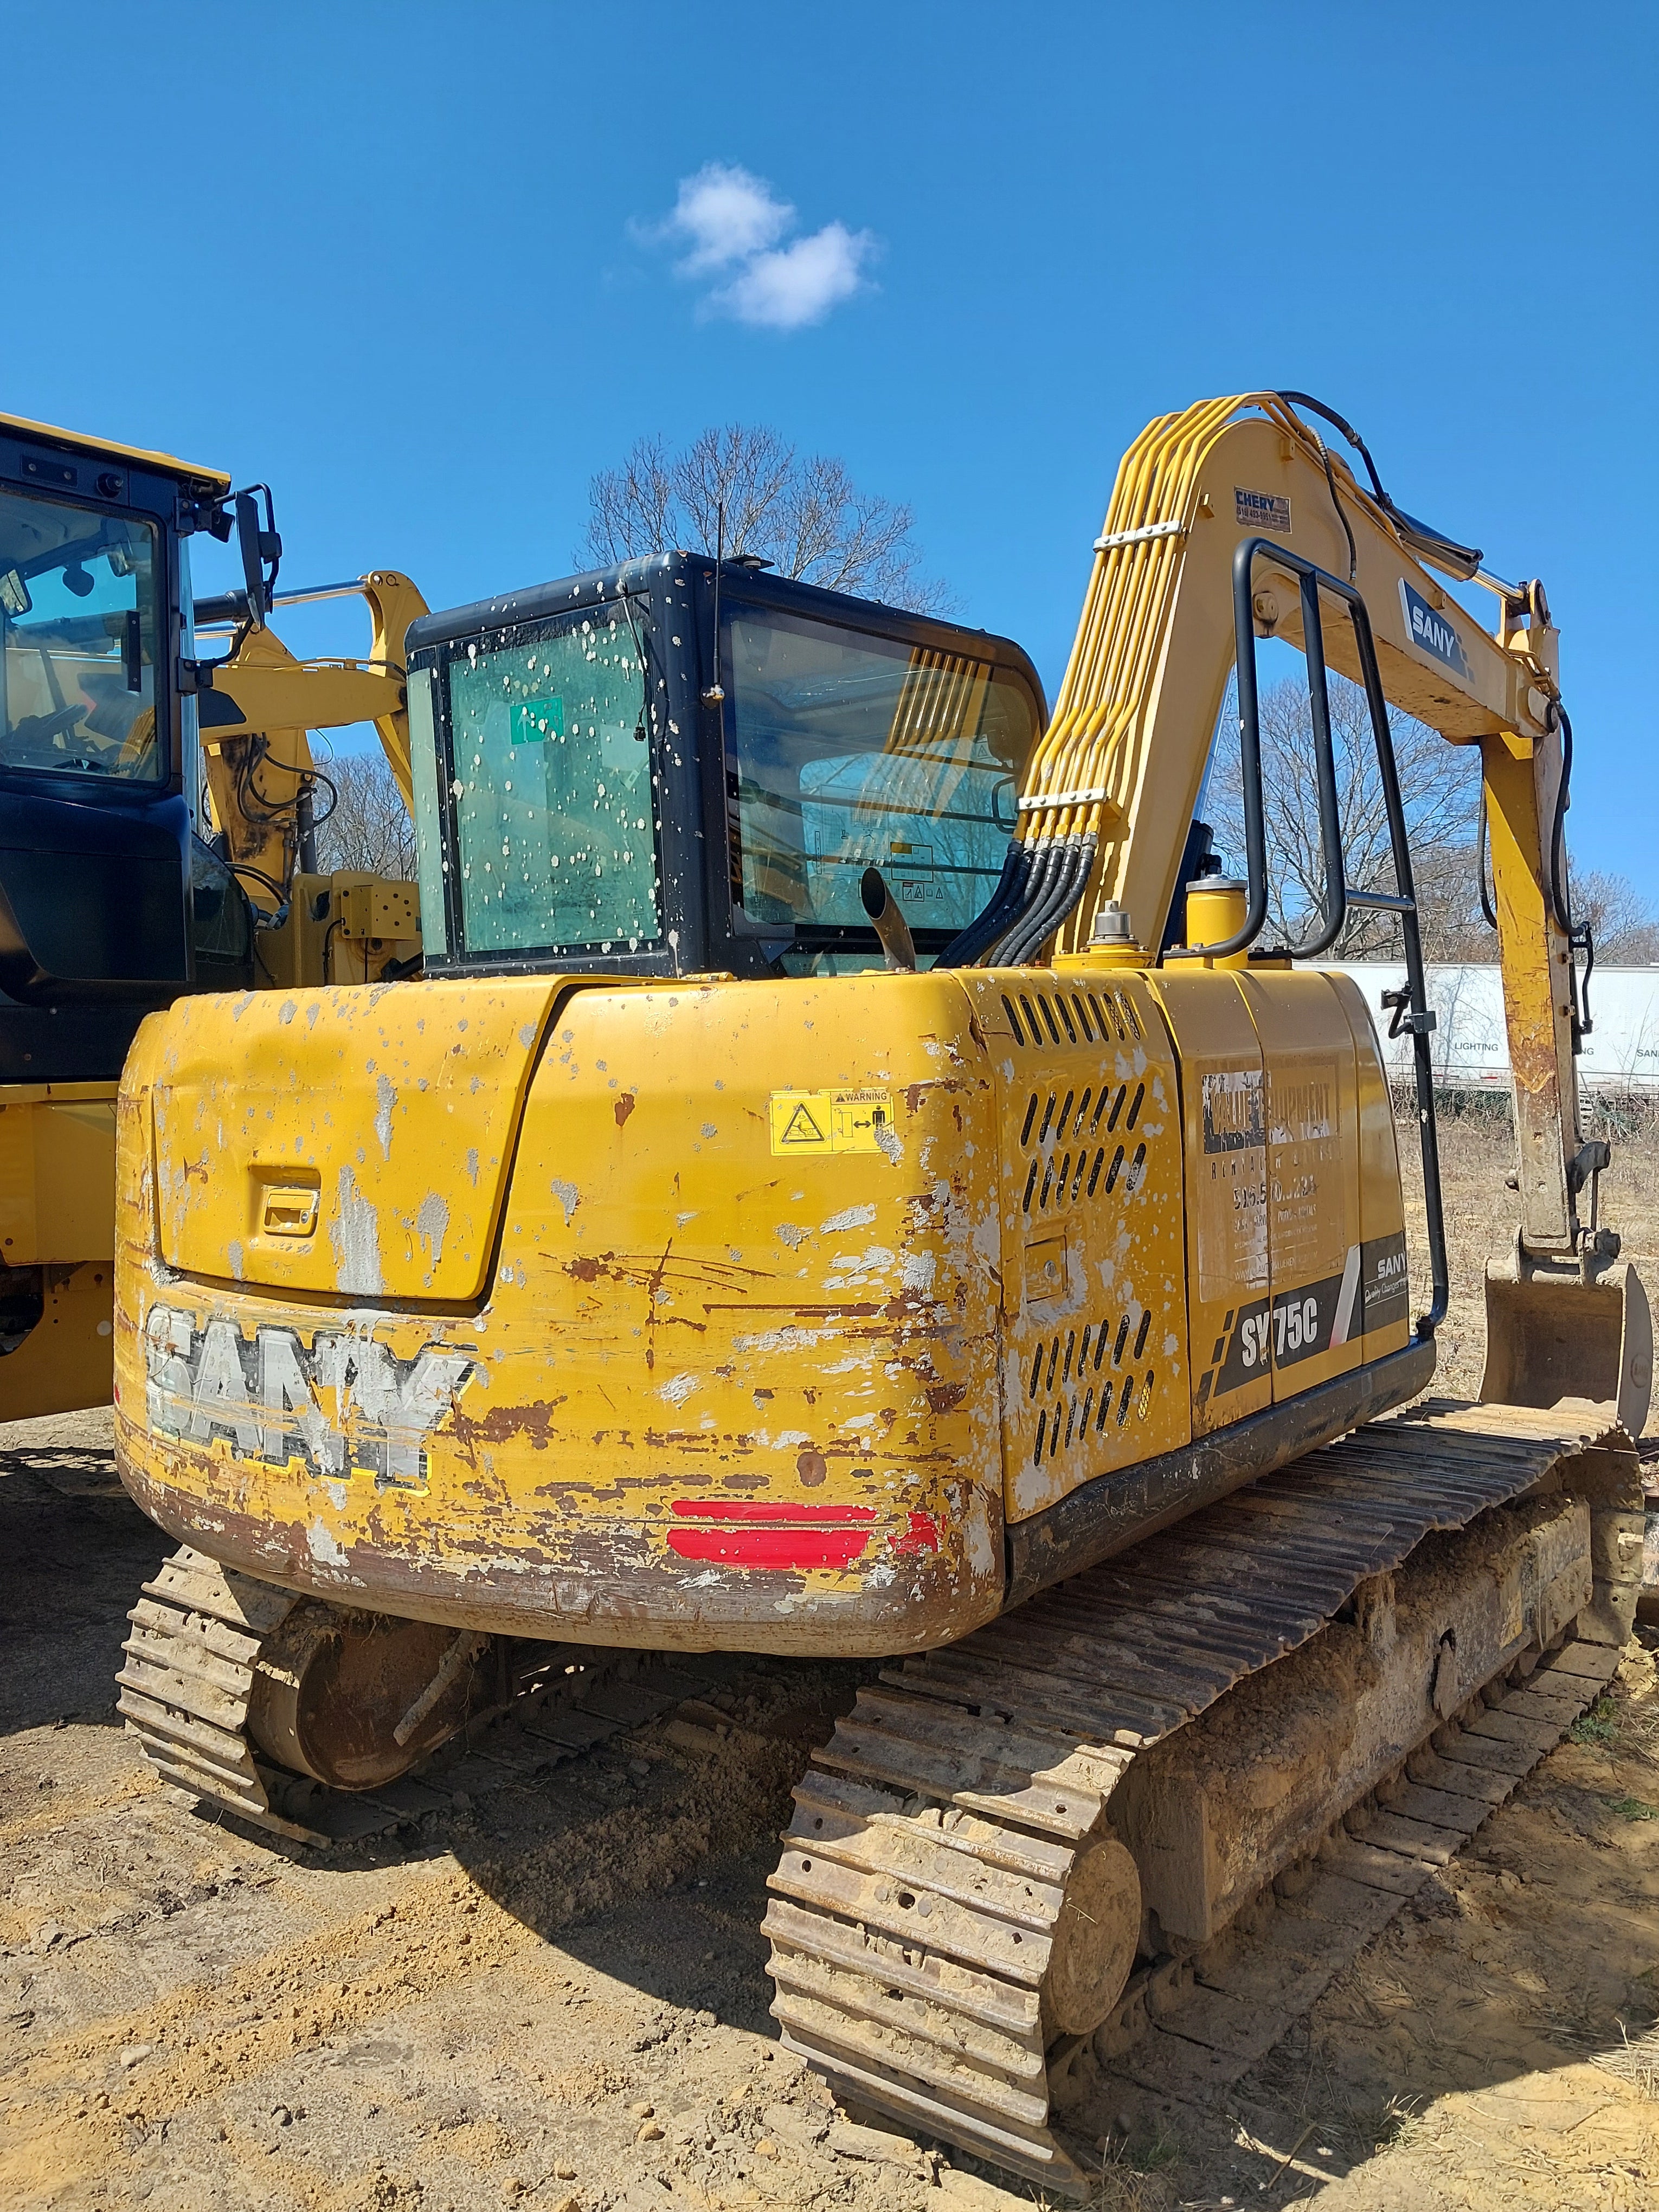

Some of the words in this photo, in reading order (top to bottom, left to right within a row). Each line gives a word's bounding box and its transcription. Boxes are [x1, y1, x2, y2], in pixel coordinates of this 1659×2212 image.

[1236, 491, 1275, 512] CHERY
[1413, 606, 1455, 658] SANY
[1455, 1043, 1499, 1051] LIGHTING
[1637, 1049, 1659, 1057] SAN
[846, 1092, 887, 1101] WARNING
[1378, 1251, 1406, 1279] SANY
[1365, 1285, 1381, 1304] Quality
[1381, 1282, 1399, 1293] Changes
[1242, 1297, 1317, 1367] SY75C
[146, 1302, 479, 1491] SANY
